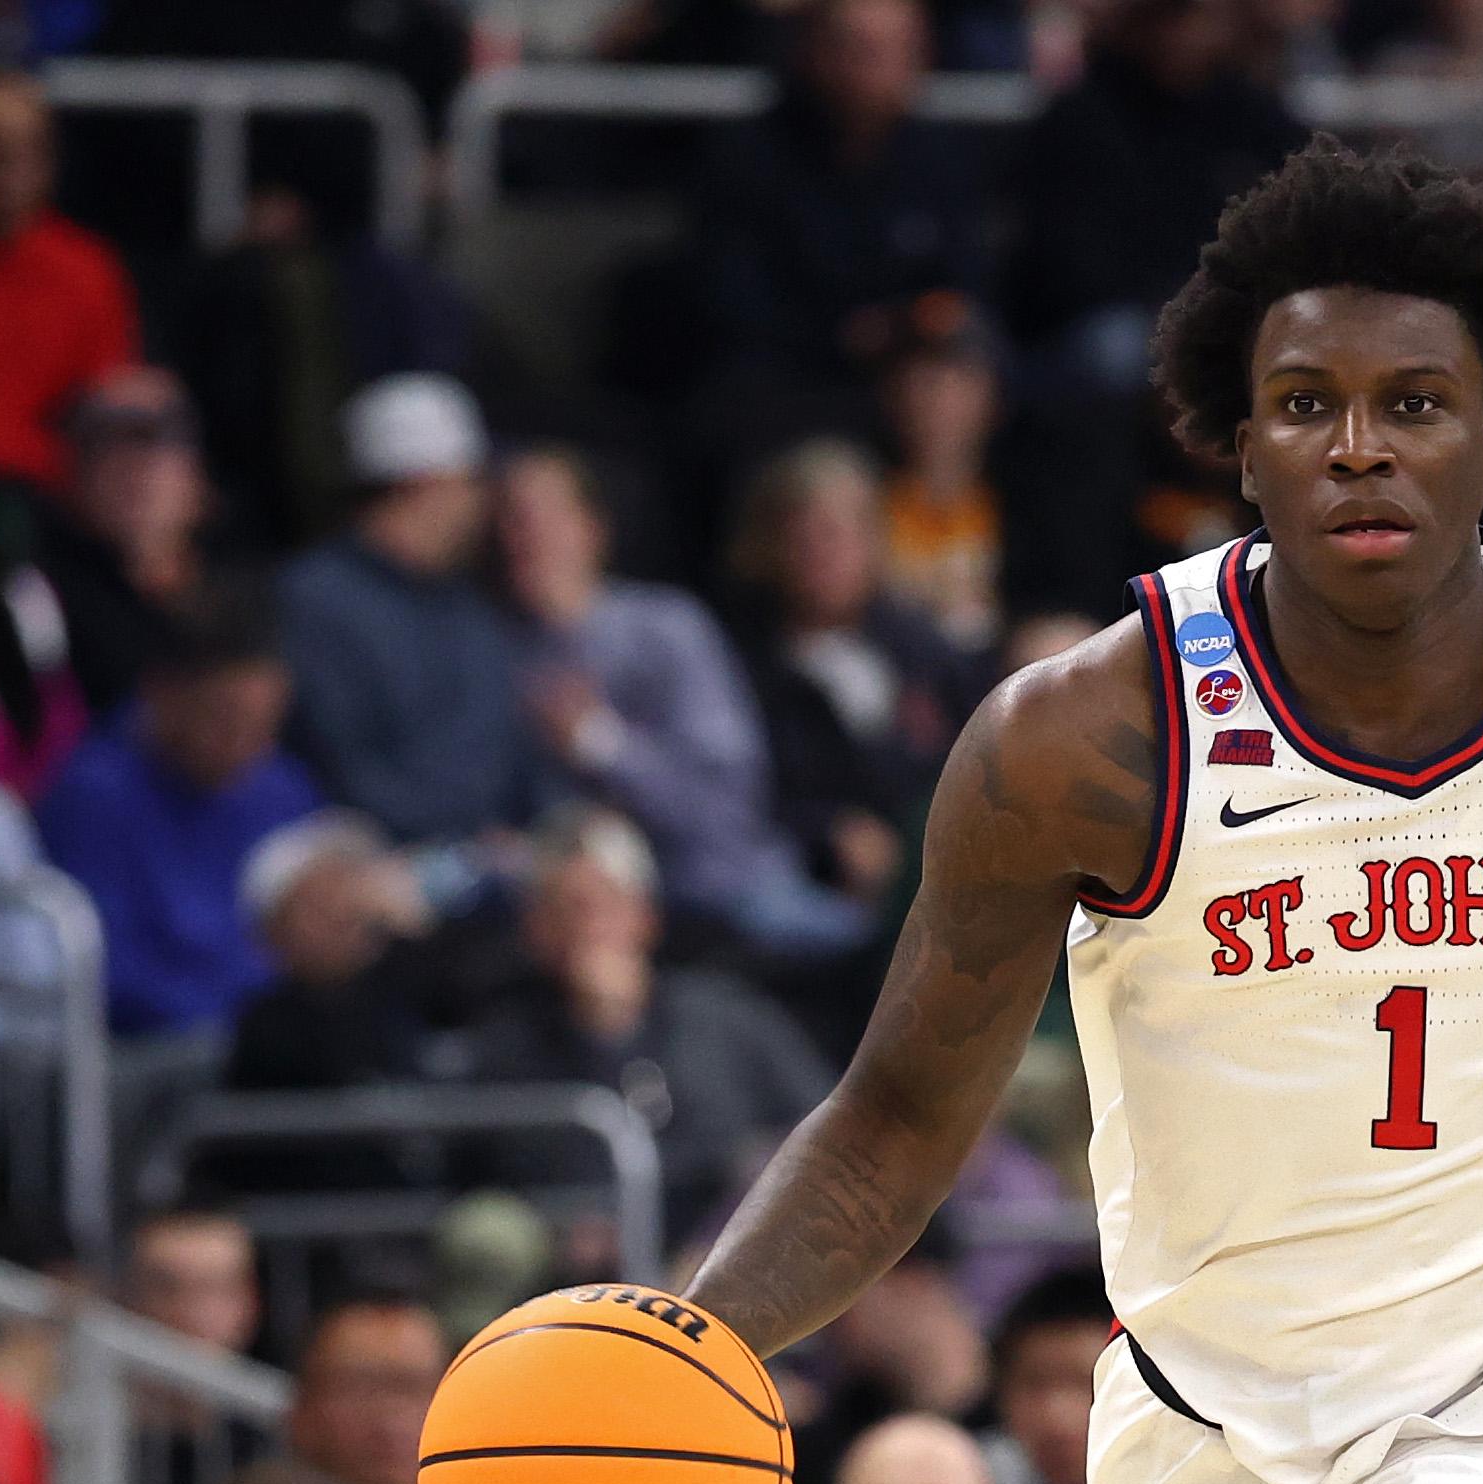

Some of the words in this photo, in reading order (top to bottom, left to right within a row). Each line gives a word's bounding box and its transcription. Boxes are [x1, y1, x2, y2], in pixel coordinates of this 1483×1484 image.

[1184, 635, 1232, 654] NCAA
[1203, 874, 1315, 976] ST.
[1371, 985, 1437, 1151] 1
